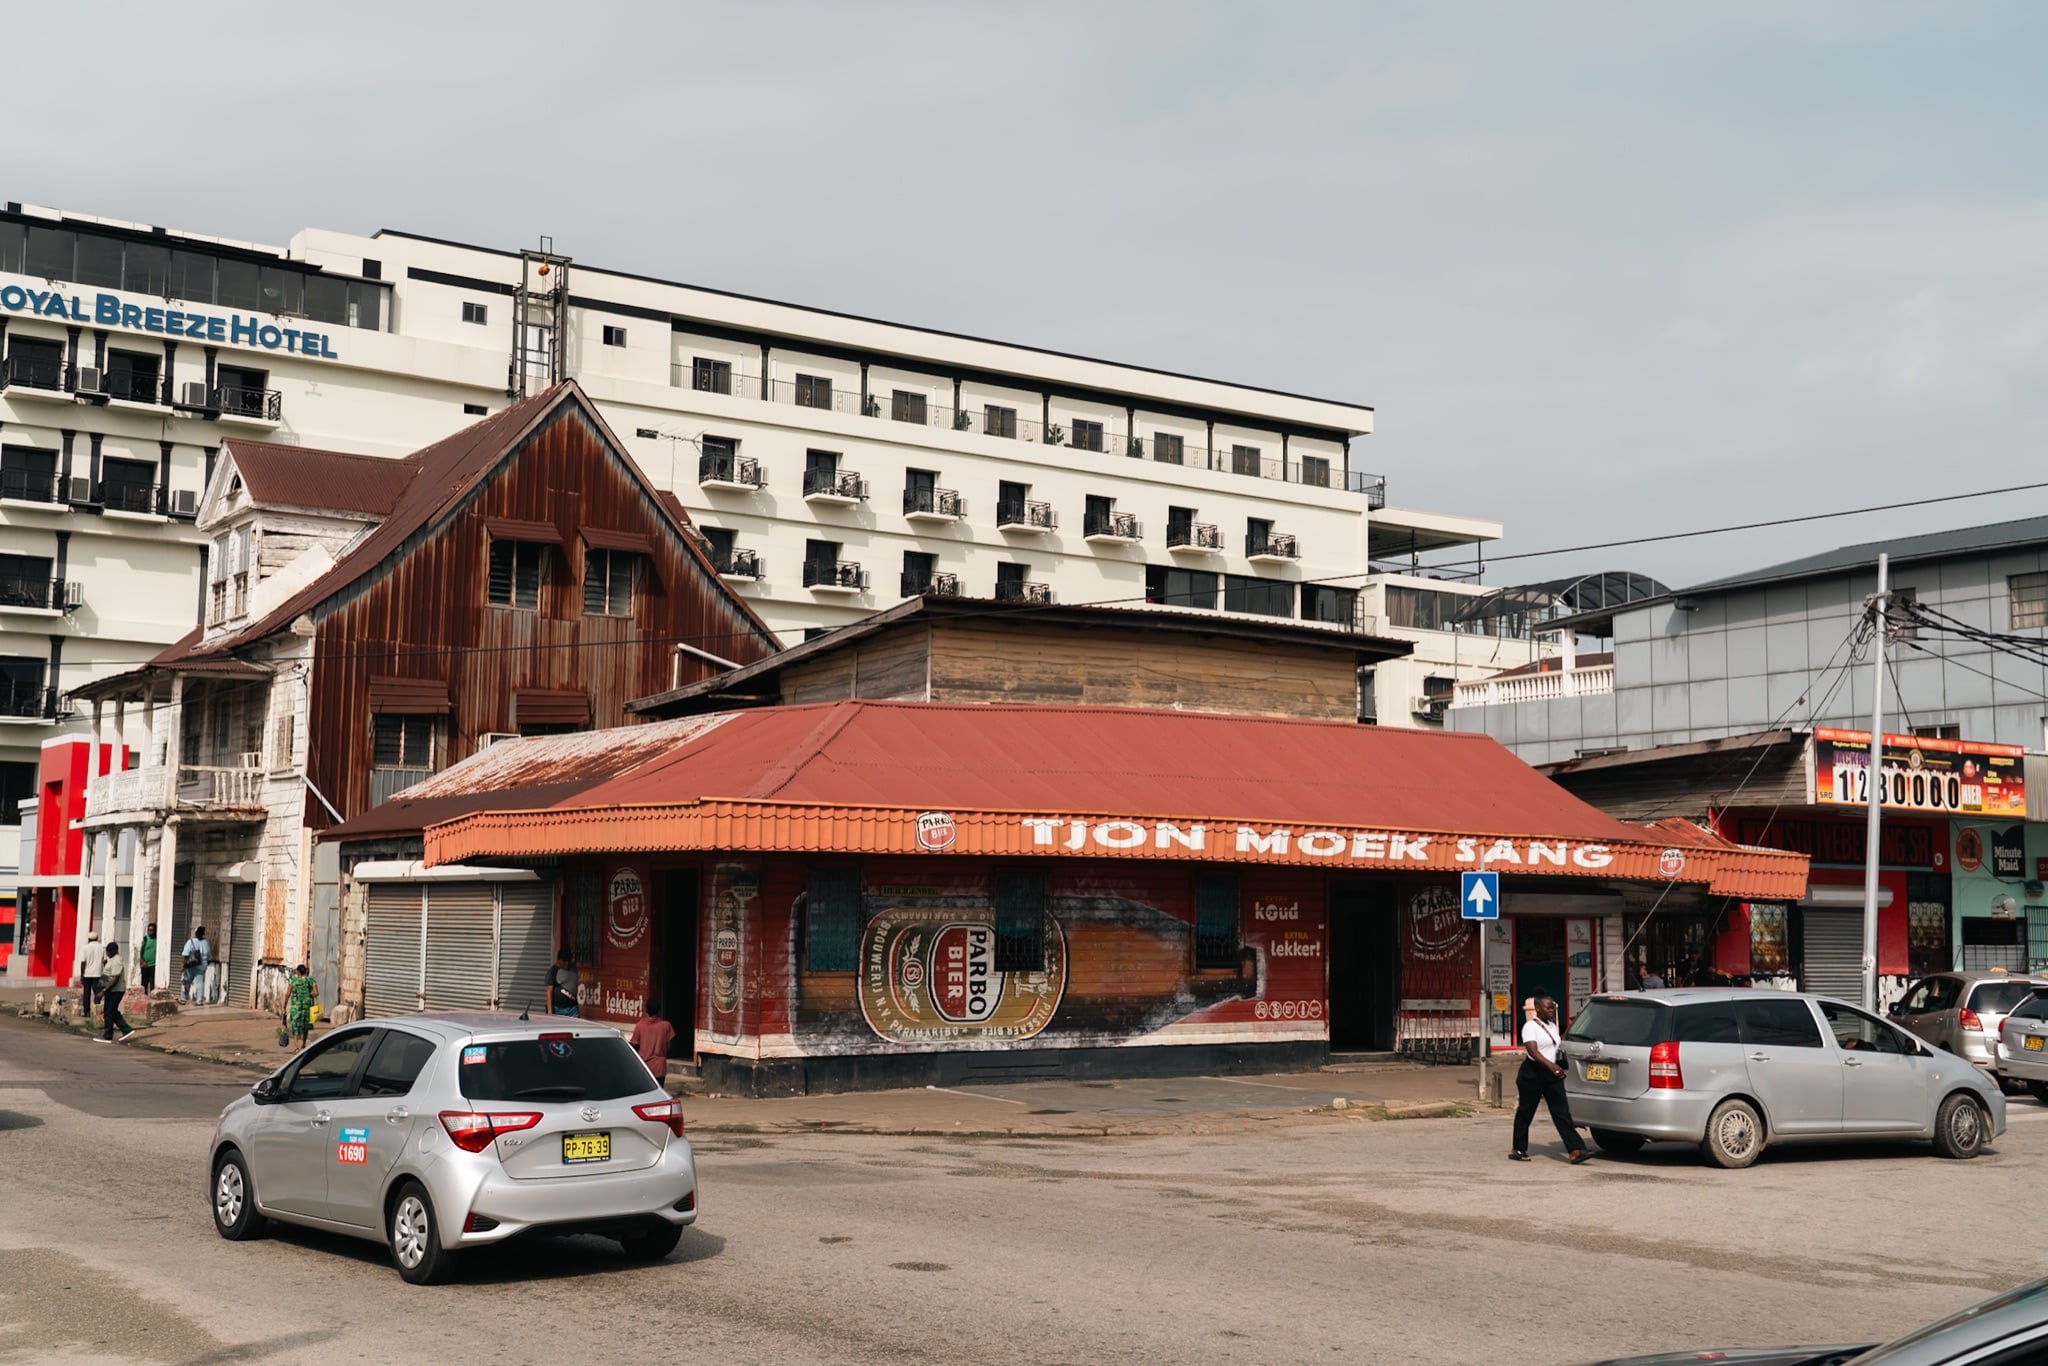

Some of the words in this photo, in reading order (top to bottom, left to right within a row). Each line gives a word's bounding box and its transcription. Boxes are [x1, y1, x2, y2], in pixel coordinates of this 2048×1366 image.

[1, 285, 91, 322] OYAL
[95, 292, 226, 342] BREEZE
[230, 313, 338, 359] HOTEL
[1833, 750, 1871, 766] JACKPO
[1961, 784, 1981, 804] HIER
[1021, 818, 1206, 851] TJON
[1234, 825, 1431, 861] MOEK
[1454, 836, 1615, 869] SANG
[1994, 845, 2022, 858] Minute
[1998, 858, 2019, 872] Maid
[1271, 940, 1320, 957] lekker!
[870, 920, 892, 994] BROUWERIJ
[889, 1019, 959, 1038] PARAMARIBO
[948, 945, 964, 999] BIER
[968, 930, 987, 1015] PARBO
[606, 990, 643, 1017] lekker!
[982, 1026, 1004, 1036] BIER
[343, 1145, 365, 1162] 1690
